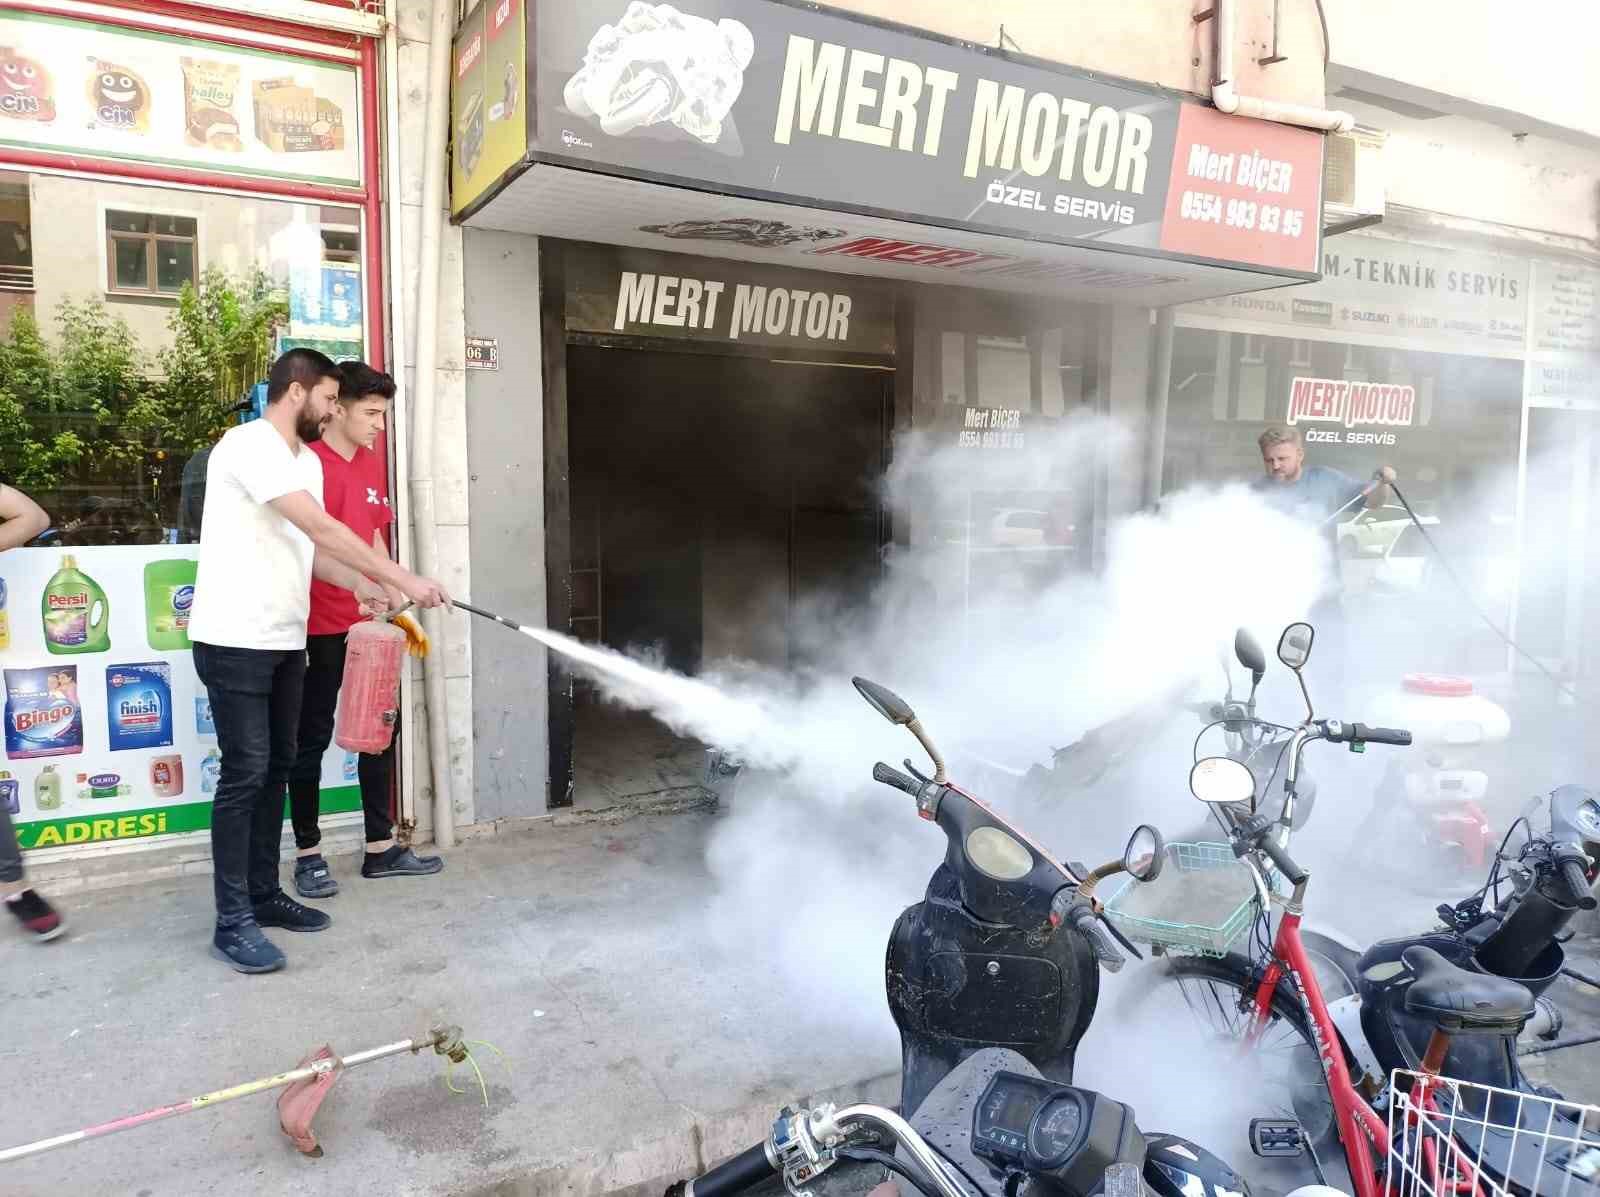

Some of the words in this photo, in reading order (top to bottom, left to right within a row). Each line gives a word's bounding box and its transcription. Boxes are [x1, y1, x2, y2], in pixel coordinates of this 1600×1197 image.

[774, 34, 959, 157] MERT
[963, 78, 1153, 194] MOTOR
[1187, 143, 1235, 184] Mert
[1236, 148, 1293, 194] BİÇER
[986, 180, 1047, 211] ÖZEL
[1053, 193, 1136, 225] SERVİS
[1180, 190, 1222, 224] 0554
[1447, 271, 1519, 300] SERVİS
[614, 272, 725, 330] MERT
[729, 283, 851, 341] MOTOR
[1288, 378, 1348, 425] MERT
[1346, 383, 1415, 428] MOTOR
[1305, 427, 1342, 443] ÖZEL
[1346, 431, 1397, 446] SERVİS
[48, 593, 88, 606] Persil
[16, 704, 73, 732] Bingo
[120, 700, 158, 716] finish
